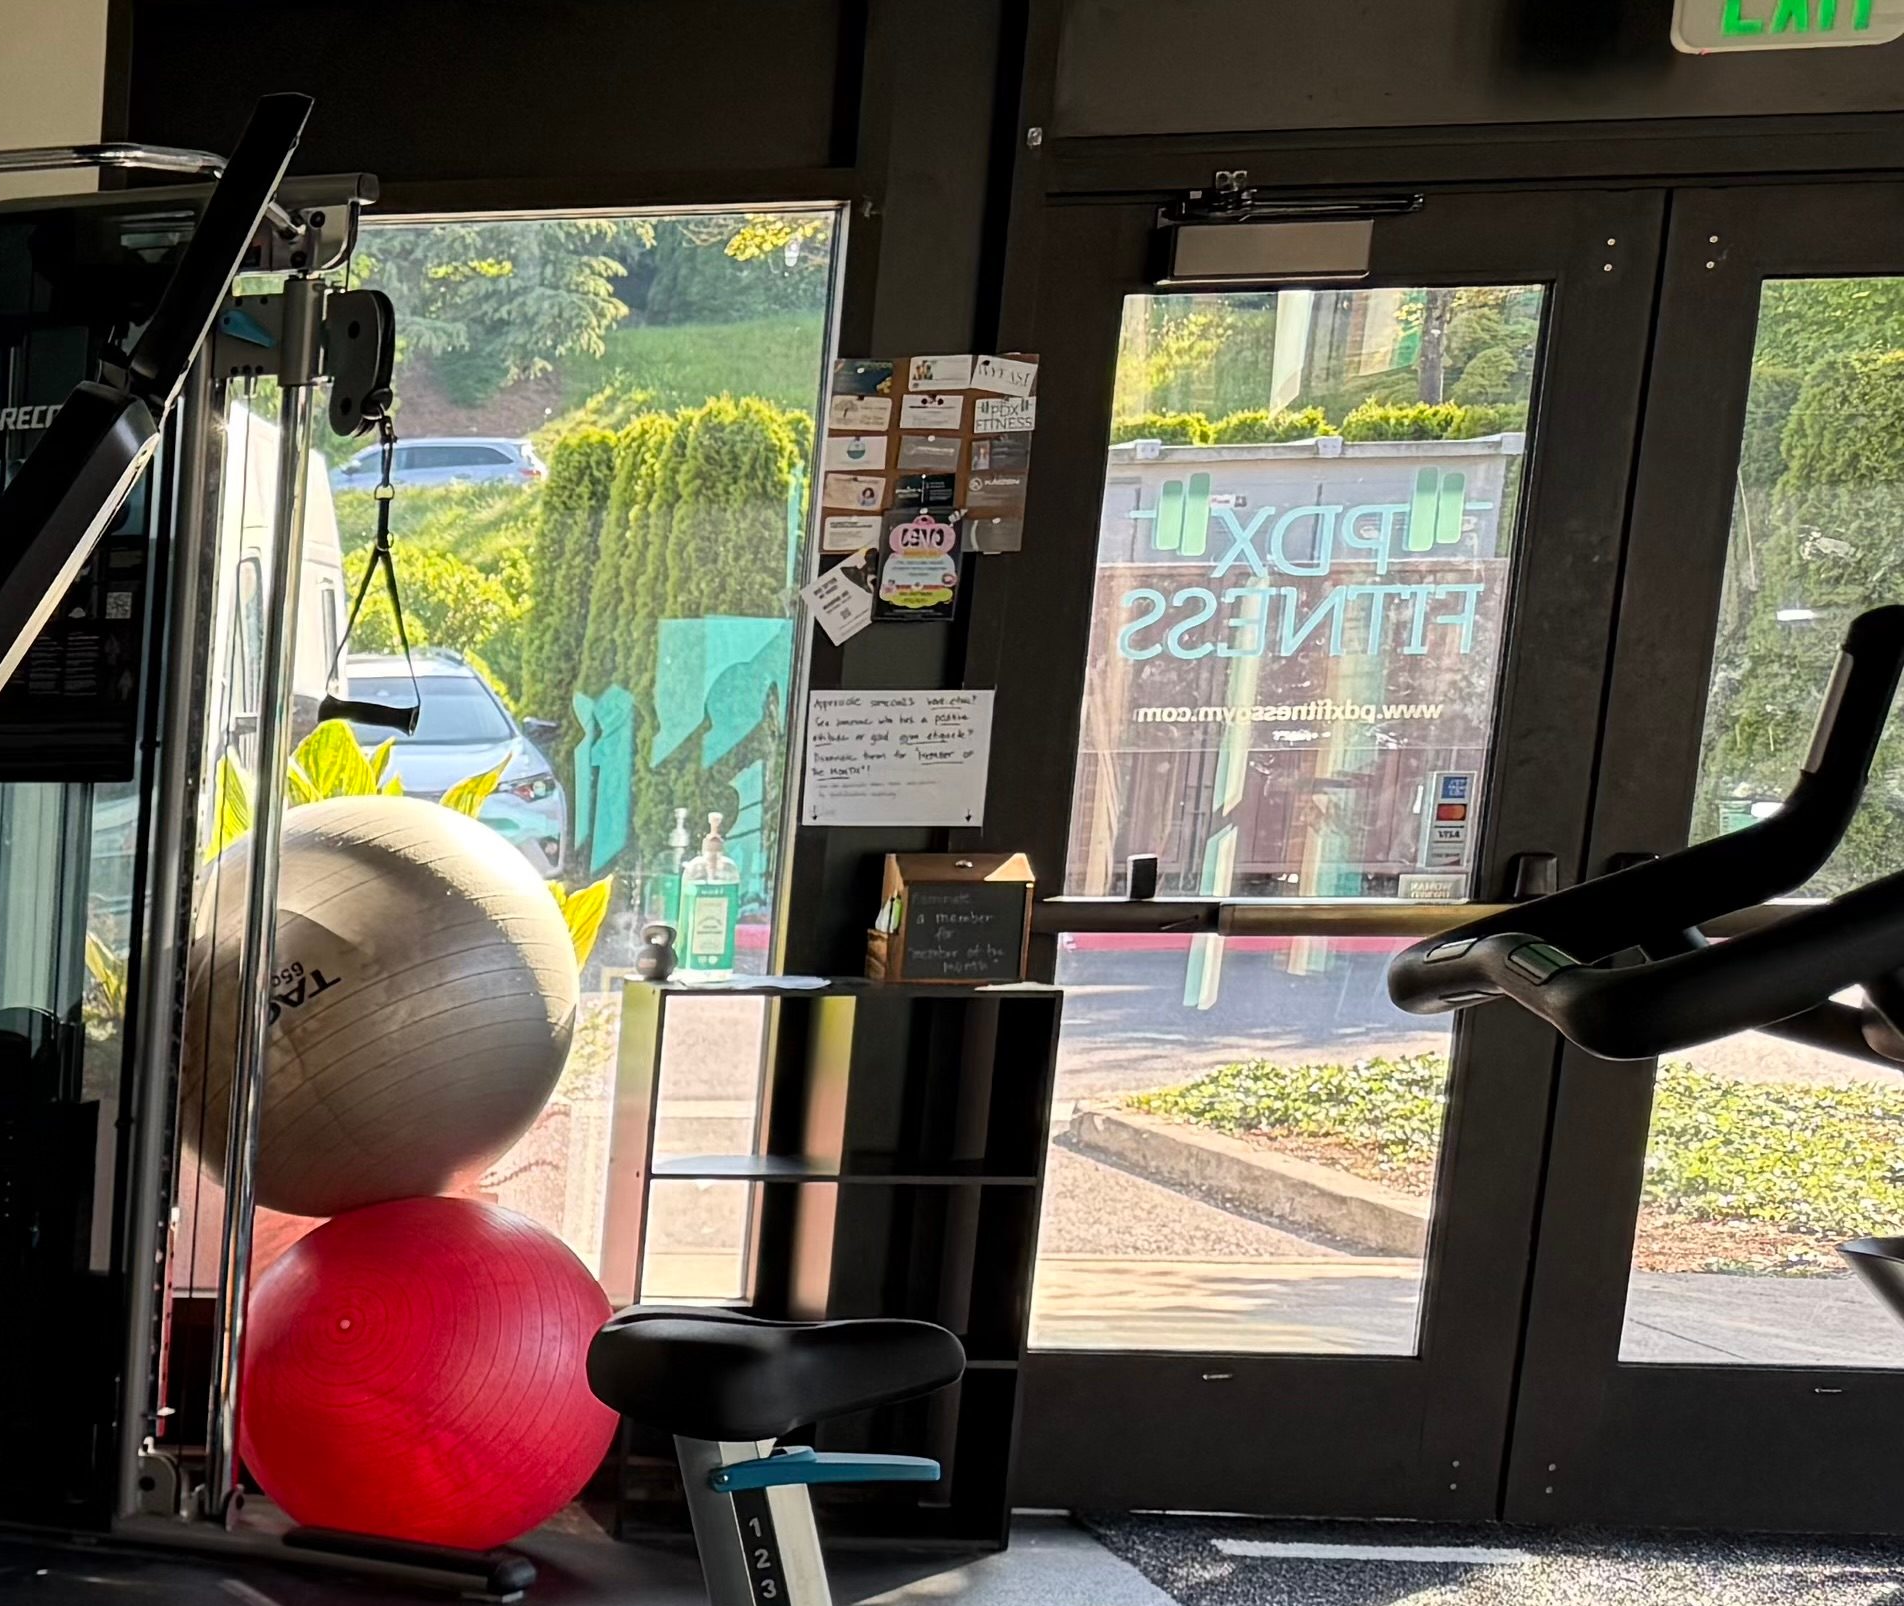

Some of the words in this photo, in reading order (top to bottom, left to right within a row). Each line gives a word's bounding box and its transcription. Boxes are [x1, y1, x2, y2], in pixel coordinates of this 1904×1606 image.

[991, 404, 1019, 415] PDX
[976, 417, 1033, 430] FITNESS
[936, 911, 993, 924] member
[749, 1517, 762, 1538] 1
[754, 1548, 772, 1570] 2
[760, 1579, 777, 1599] 3
